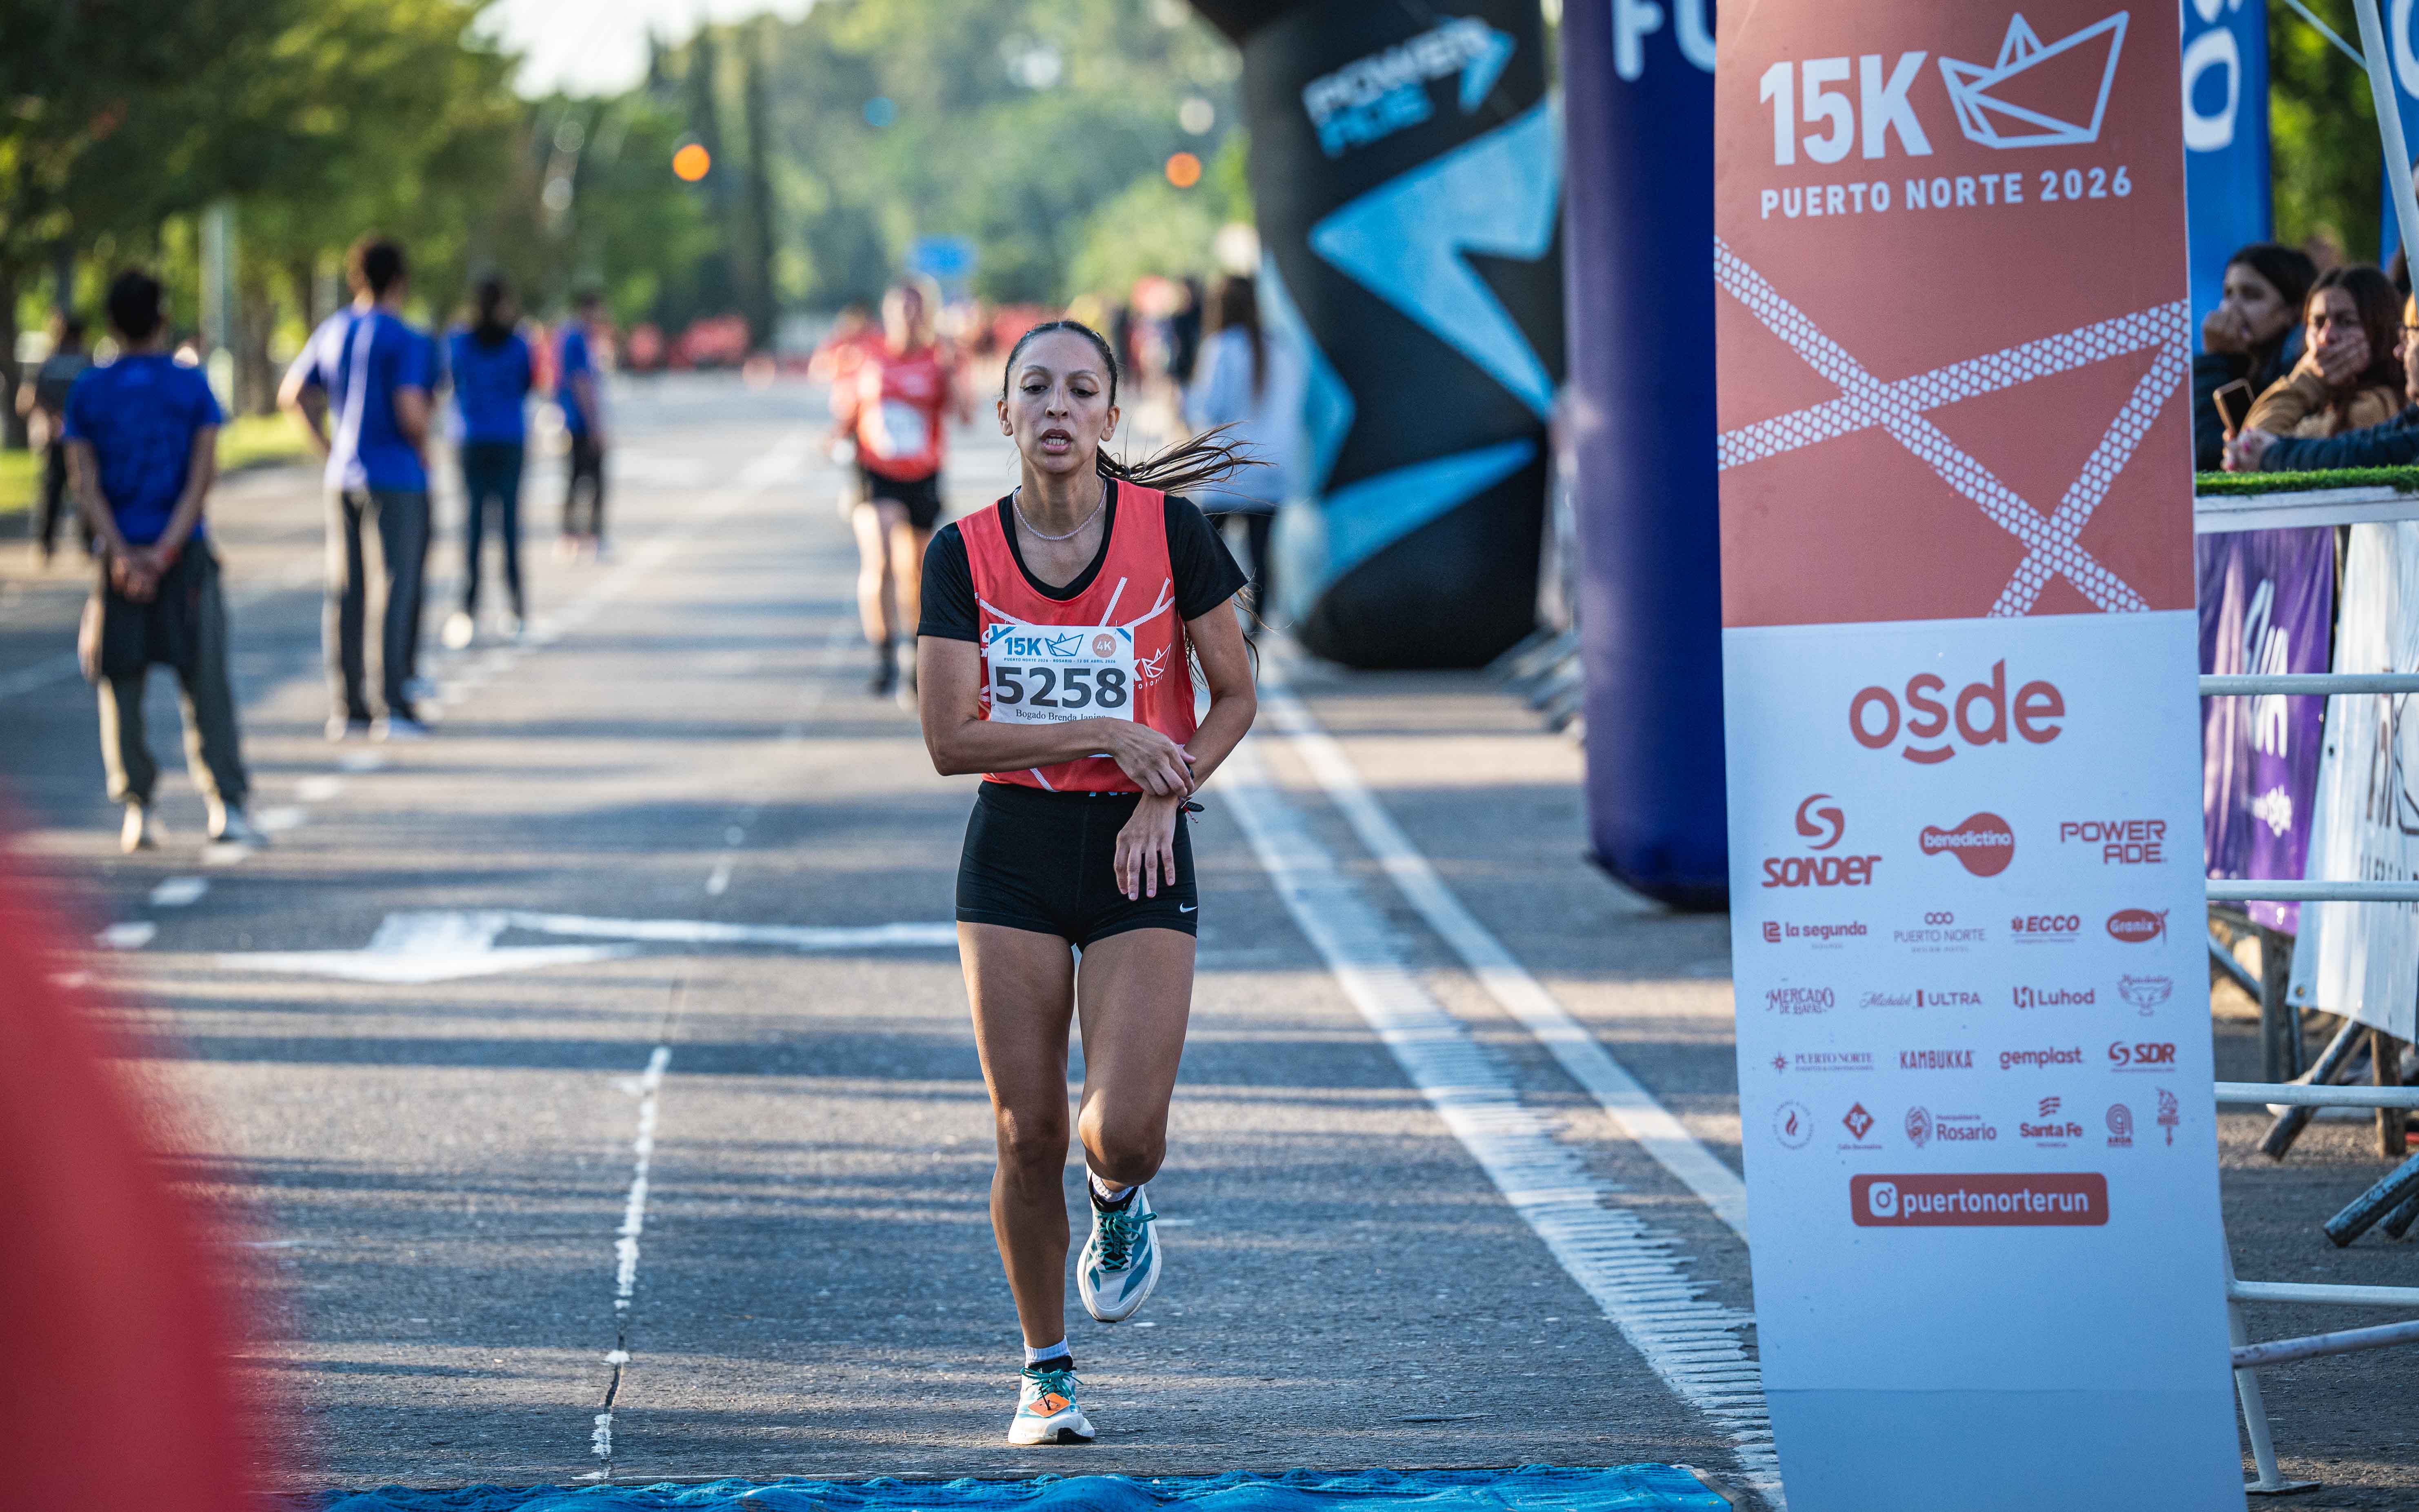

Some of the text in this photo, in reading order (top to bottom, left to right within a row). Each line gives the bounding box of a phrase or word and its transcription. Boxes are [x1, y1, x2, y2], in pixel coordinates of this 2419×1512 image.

[1759, 51, 1933, 166] 15K
[1761, 167, 2132, 220] PUERTO NORTE 2026
[1004, 637, 1042, 656] 15K
[1097, 641, 1112, 651] 4K
[996, 667, 1127, 708] 5258
[1849, 658, 2065, 750] osde
[1016, 709, 1046, 719] Bogado
[1049, 712, 1077, 721] Brenda
[1924, 830, 2012, 848] benedictino
[2061, 820, 2166, 843] POWER
[2104, 842, 2161, 864] ADE
[1785, 921, 1867, 939] la segunda
[2026, 915, 2080, 932] ECCO
[1894, 928, 1985, 942] PUERTO NORTE
[1766, 986, 1835, 1011] MERCADO
[1928, 992, 1981, 1006] ULTRA
[2038, 988, 2095, 1006] Luhod
[1900, 1050, 1973, 1069] KAMBUKKA
[2000, 1047, 2081, 1069] gemplast
[2135, 1043, 2175, 1064] SDR
[1937, 1123, 1997, 1140] Rosario
[2020, 1122, 2083, 1137] Santa Fe
[1903, 1188, 2089, 1219] puertonorterun
